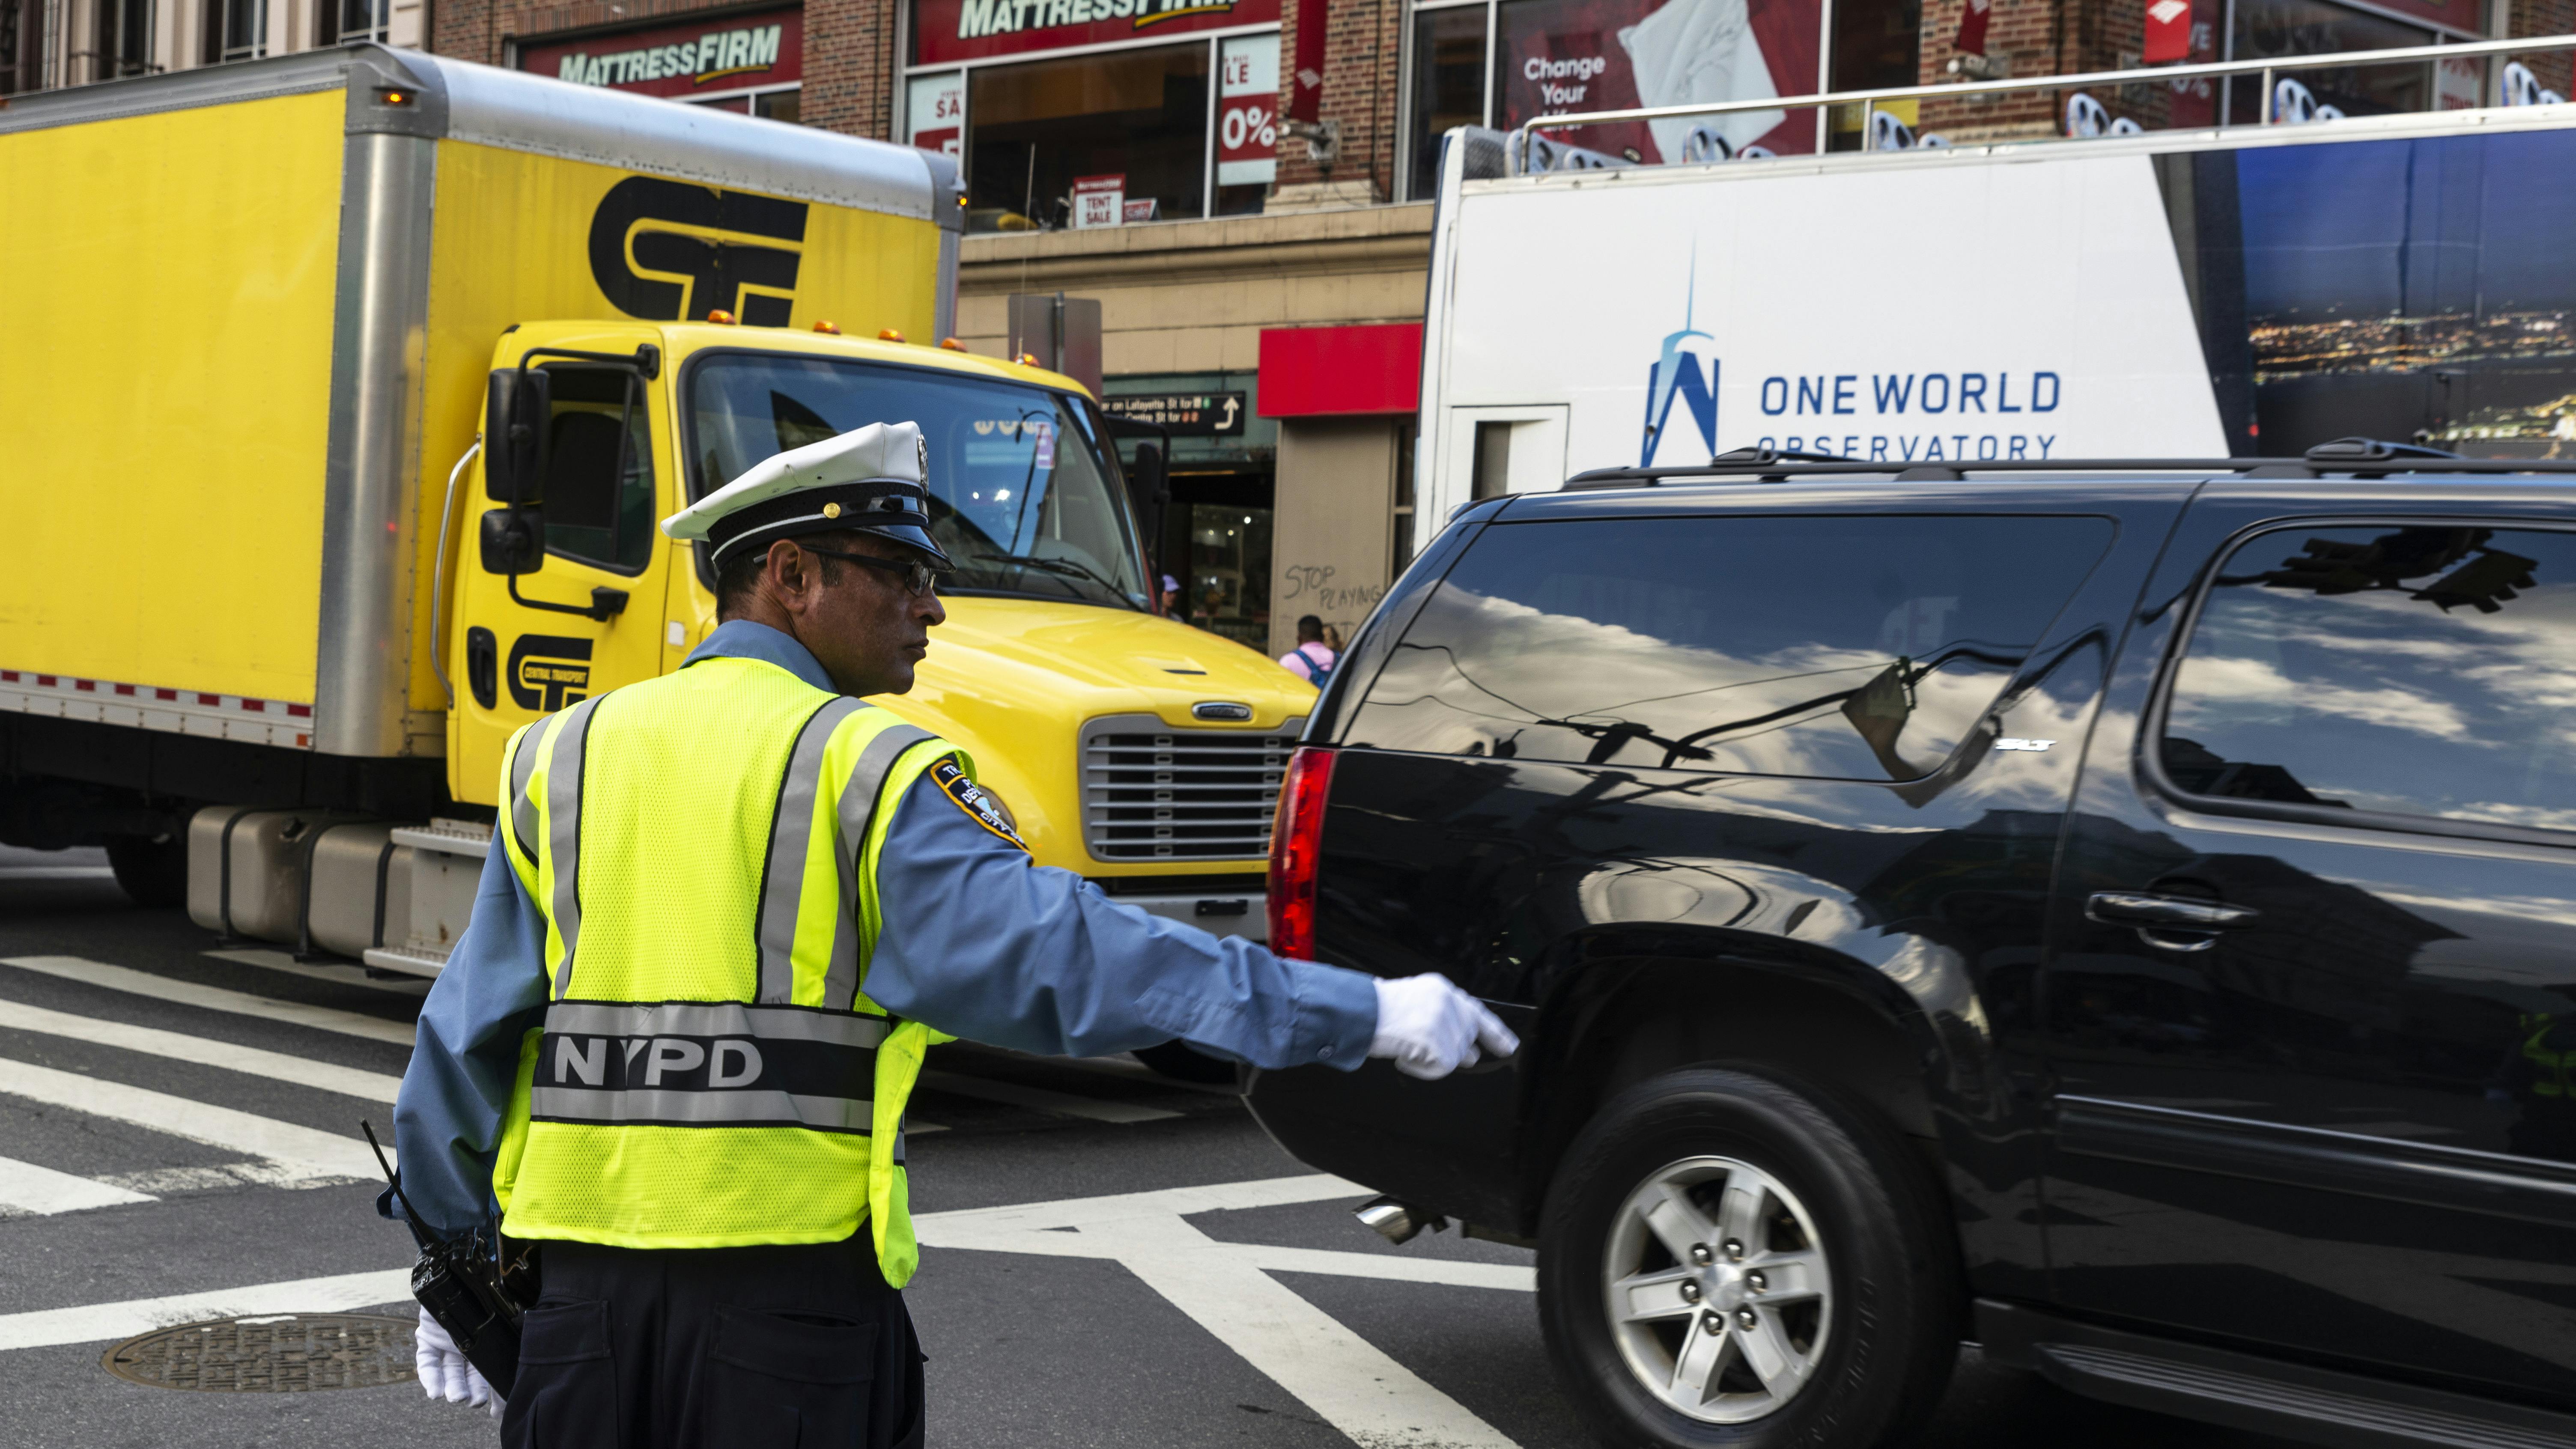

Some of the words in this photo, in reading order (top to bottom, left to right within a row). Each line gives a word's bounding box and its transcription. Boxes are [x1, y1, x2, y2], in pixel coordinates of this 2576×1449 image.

[1524, 56, 1605, 80] Change
[1541, 83, 1587, 105] Your
[1086, 196, 1111, 209] TENT
[1086, 211, 1110, 224] SALE
[1125, 399, 1165, 412] Lafayette
[1761, 375, 1857, 416] ONE
[1873, 372, 2060, 414] WORLD
[1284, 565, 1336, 599] STOP
[1319, 584, 1382, 610] PLAYING
[1996, 738, 2057, 751] SLT
[554, 1036, 763, 1088] NYPD
